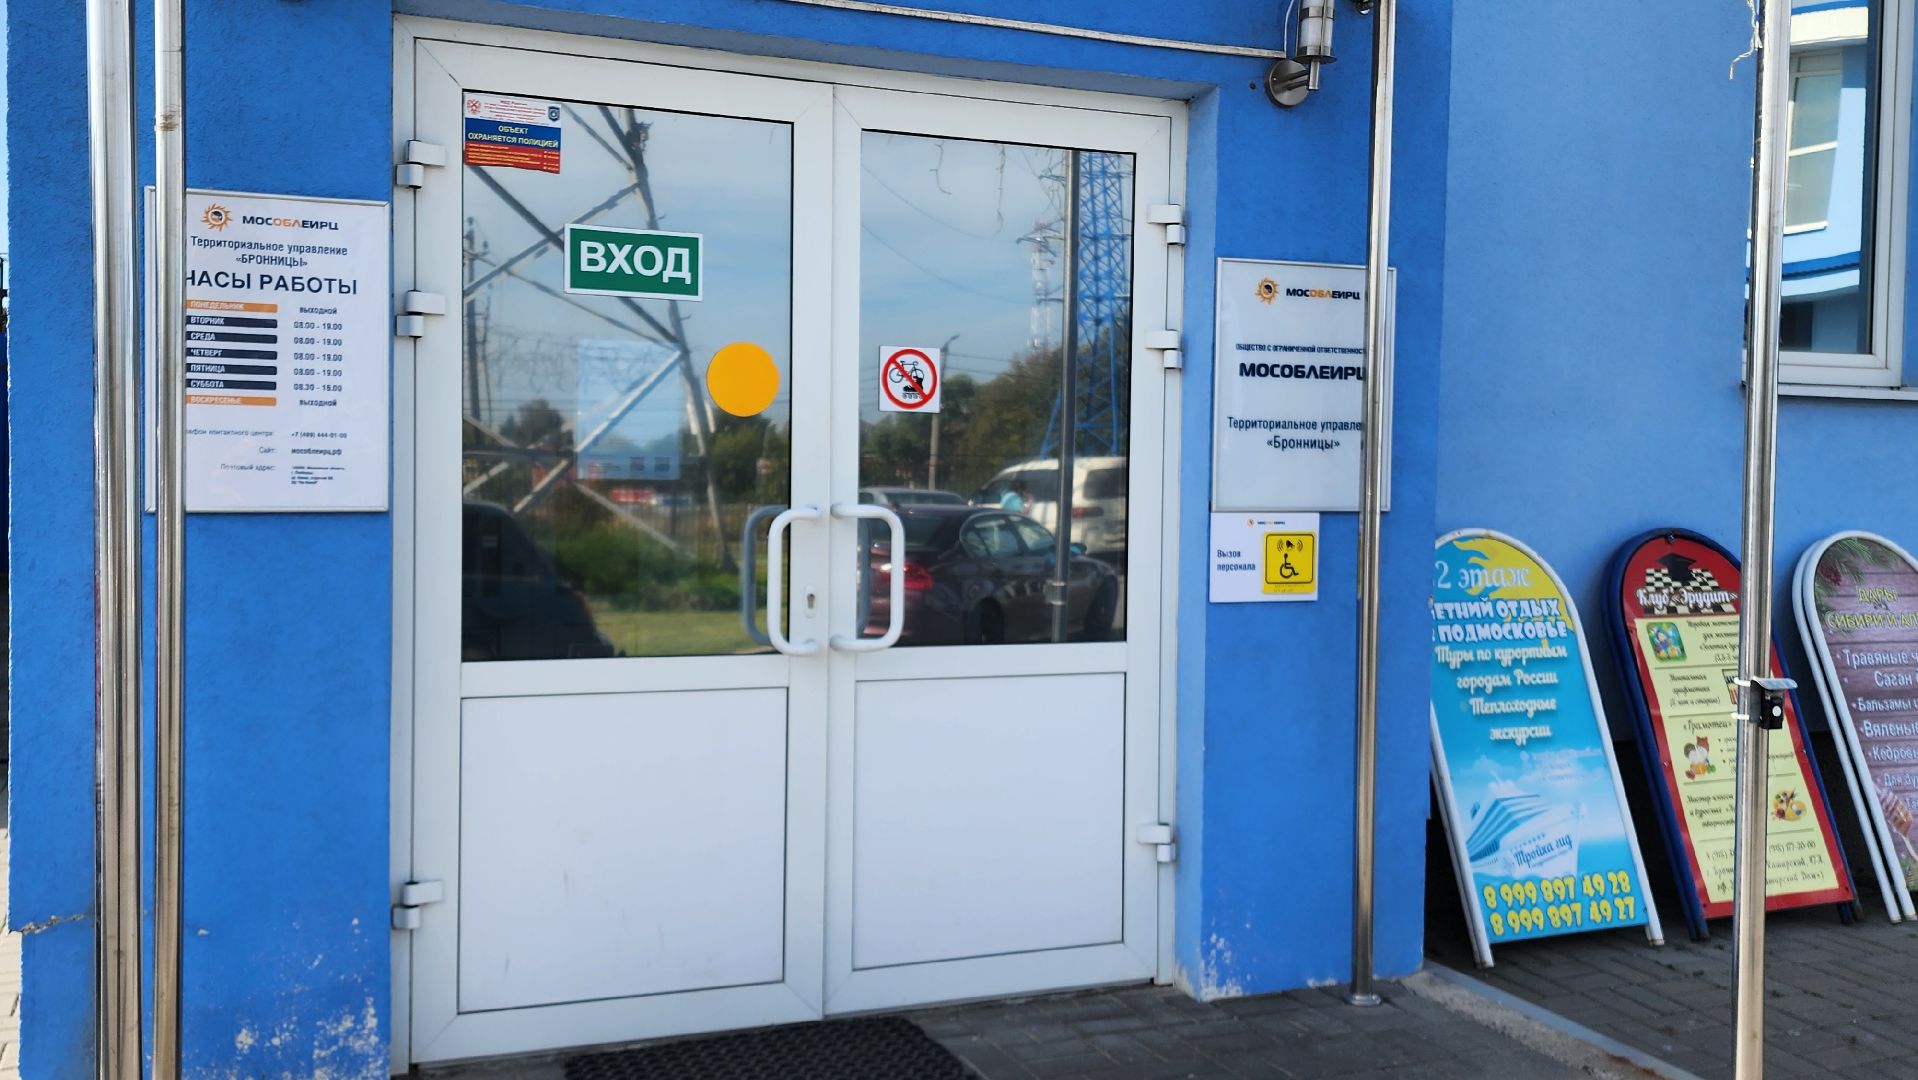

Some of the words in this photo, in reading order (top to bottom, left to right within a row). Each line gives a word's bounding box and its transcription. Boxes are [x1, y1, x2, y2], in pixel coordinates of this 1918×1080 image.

[498, 126, 528, 134] ОБЪЕКТ
[468, 133, 517, 142] ОХРАНЯЕТСЯ
[518, 138, 558, 148] ПОЛИЦИЕЙ
[242, 216, 339, 230] МОСОБЛЕИРЦ
[191, 236, 284, 252] Территориальное
[287, 243, 348, 256] управление
[236, 254, 308, 268] «БРОННИЦЫ»
[580, 241, 691, 284] ВХОД
[260, 274, 357, 294] РАБОТЫ
[1286, 288, 1360, 300] МОСОБЛЕИРЦ
[190, 316, 224, 325] ВТОРНИК
[190, 332, 216, 340] СРЕДА
[1236, 344, 1266, 352] ОБЩЕСТВО
[1272, 344, 1316, 352] ОГРАНИЧЕННОЙ
[190, 364, 226, 373] ПЯТНИЦА
[1239, 363, 1366, 380] МОСОБЛЕИРЦ
[190, 380, 224, 388] СУББОТА
[1228, 416, 1316, 432] Территориальное
[1320, 420, 1365, 433] управле
[1266, 436, 1340, 450] «Бронницы»
[1216, 550, 1241, 558] Вызов
[1216, 563, 1256, 572] персонала
[1434, 560, 1451, 589] 2
[1458, 567, 1532, 588] этаж
[1636, 587, 1670, 609] Клуб
[1672, 586, 1739, 610] «Эрудит»
[1858, 587, 1896, 602] ДАРЫ
[1431, 597, 1494, 620] ЕТНИЙ
[1496, 599, 1562, 618] ОТДЫХ
[1826, 612, 1884, 629] СИБИРИ
[1886, 613, 1897, 626] И
[1438, 621, 1568, 643] ПОДМОСКОВЬЕ
[1435, 646, 1474, 670] Туры
[1476, 649, 1492, 660] по
[1842, 650, 1908, 669] Травяные
[1456, 672, 1511, 694] городам
[1514, 668, 1558, 684] России
[1874, 670, 1912, 688] Саган
[1469, 698, 1556, 718] Теплоходные
[1858, 697, 1912, 712] Бальзамы
[1483, 885, 1497, 910] 8
[1500, 880, 1538, 908] 999
[1540, 876, 1576, 902] 897
[1582, 873, 1606, 897] 49
[1607, 870, 1632, 894] 28
[1490, 912, 1504, 936] 8
[1507, 907, 1544, 933] 999
[1547, 902, 1582, 928] 897
[1589, 899, 1612, 924] 49
[1614, 896, 1635, 920] 27
